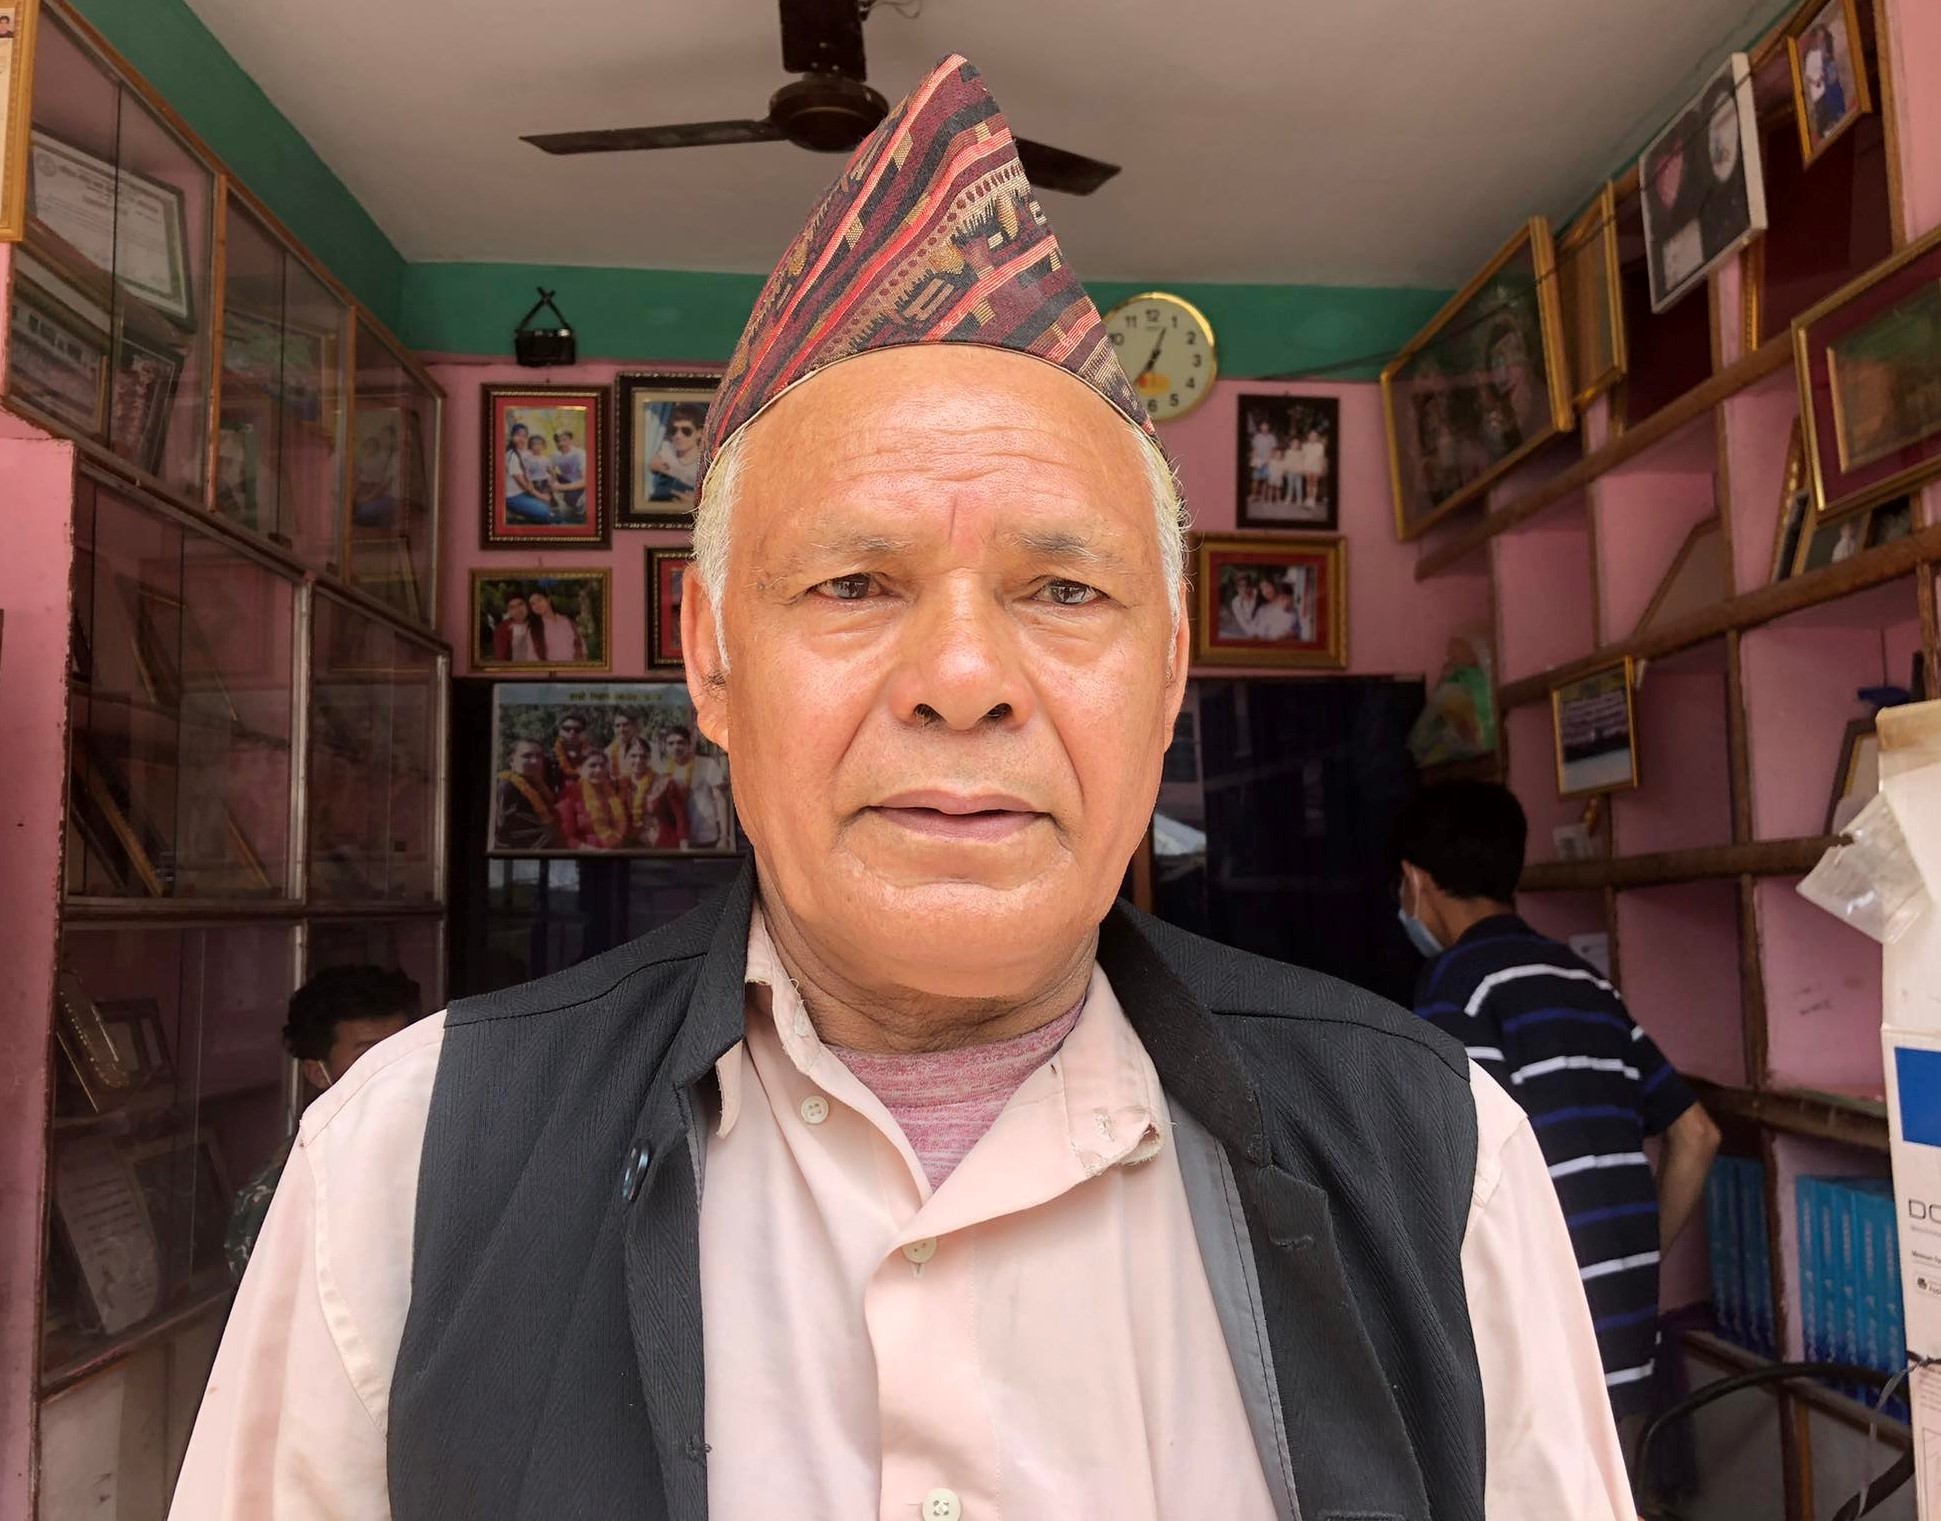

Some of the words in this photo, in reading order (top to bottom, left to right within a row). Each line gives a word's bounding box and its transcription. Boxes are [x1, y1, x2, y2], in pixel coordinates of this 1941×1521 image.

[1125, 316, 1137, 328] 11
[1145, 309, 1160, 322] 12
[1171, 315, 1178, 329] 1
[1186, 331, 1196, 345] 2
[1192, 354, 1202, 368] 3
[1185, 377, 1195, 389] 4
[1147, 399, 1157, 413] 6
[1169, 393, 1179, 407] 5
